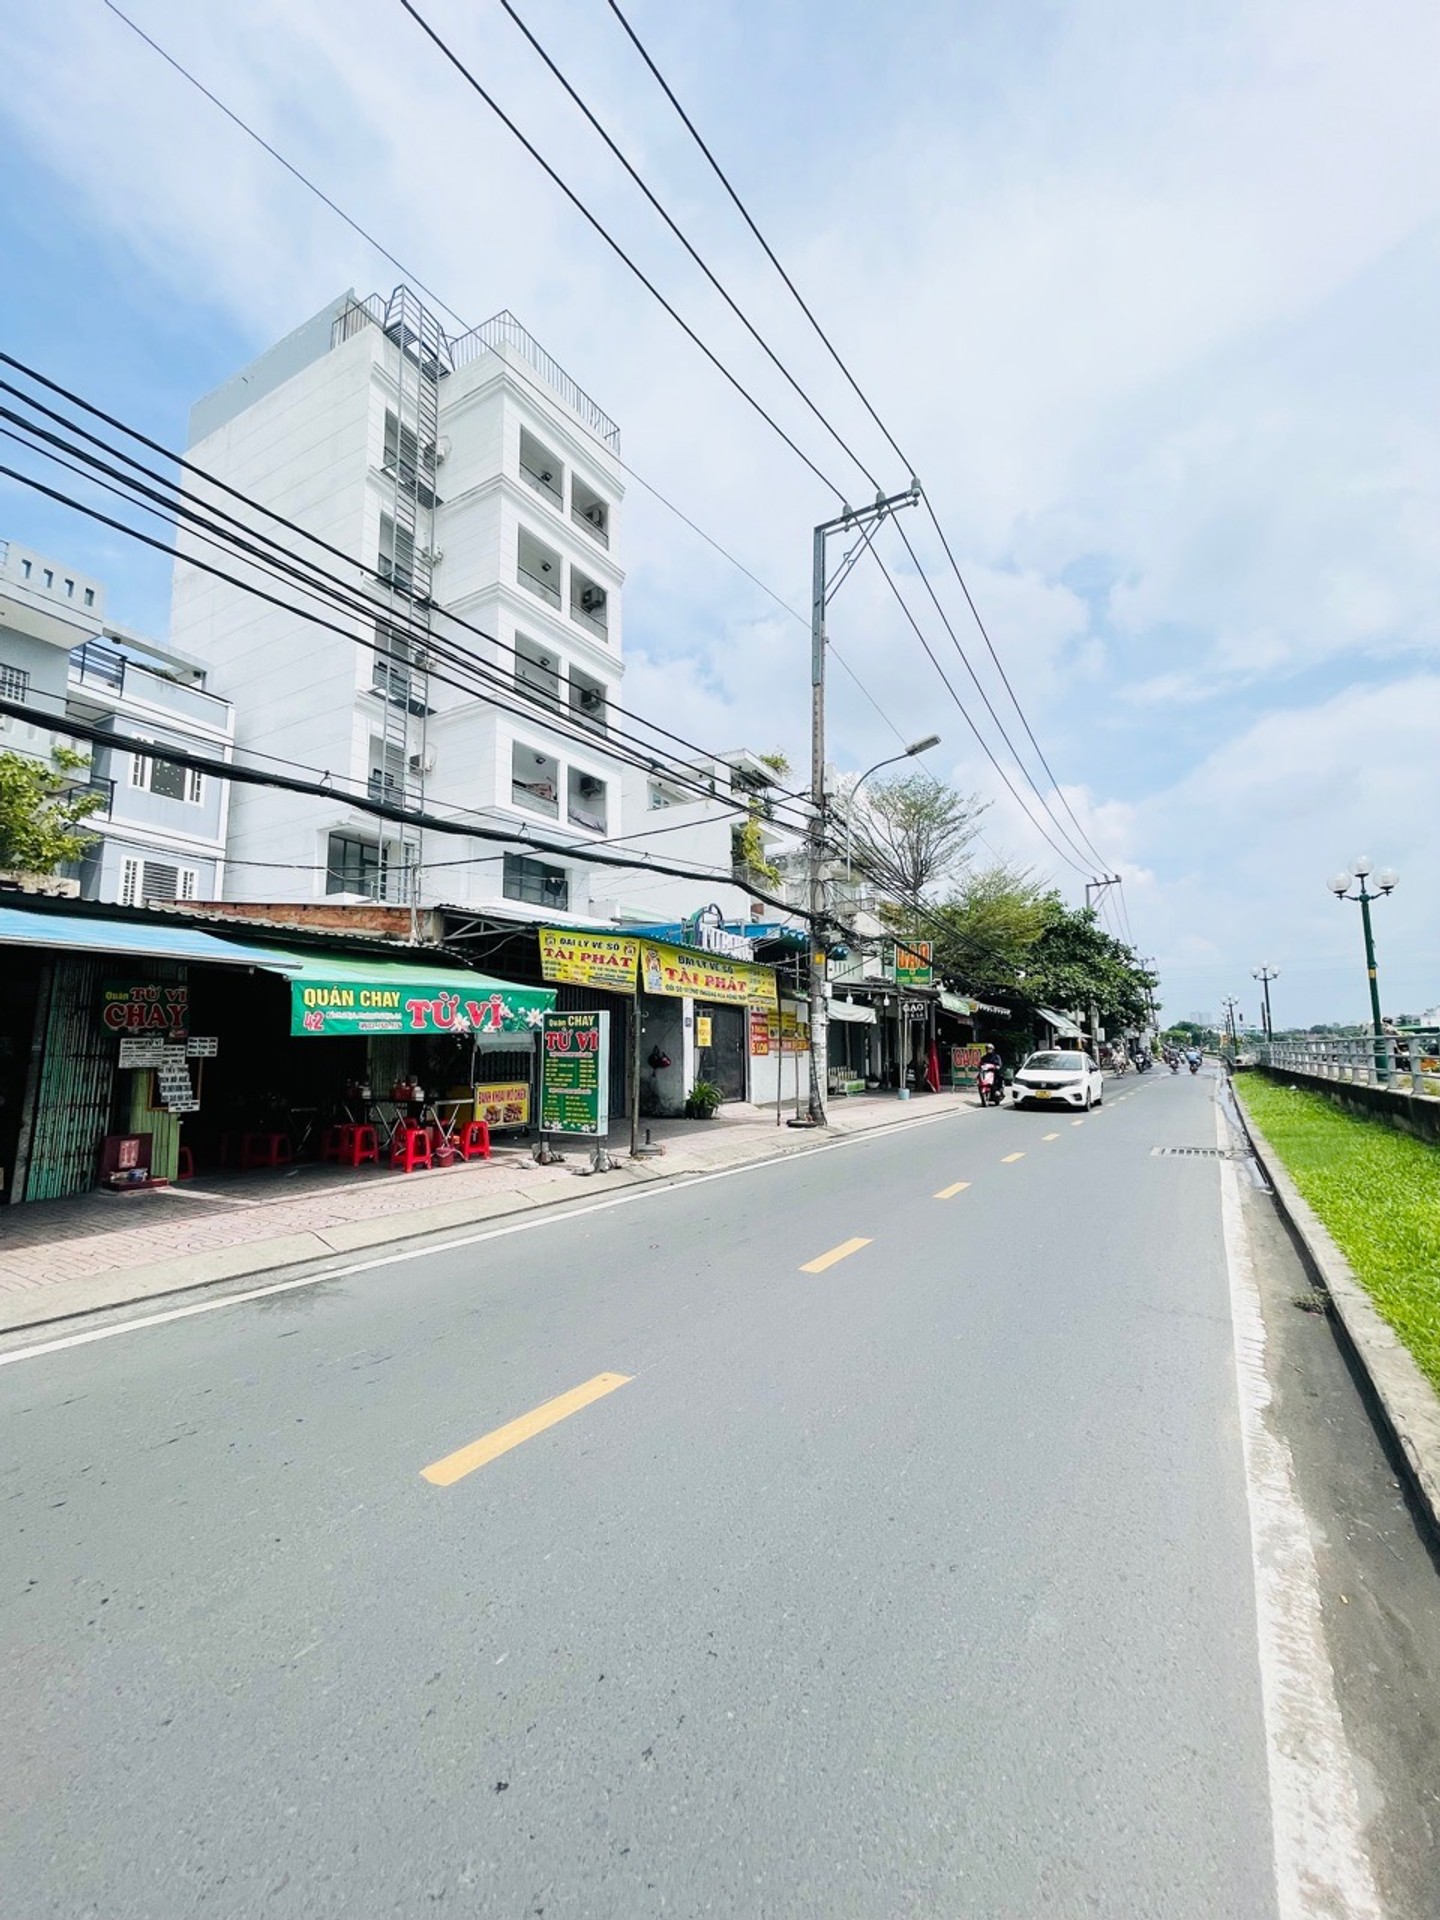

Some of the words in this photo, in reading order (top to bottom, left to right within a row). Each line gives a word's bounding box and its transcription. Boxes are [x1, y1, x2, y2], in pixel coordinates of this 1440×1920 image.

[664, 967, 699, 986] TÀI
[704, 974, 748, 992] PHÁT
[304, 986, 354, 1007] QUÁN
[360, 990, 400, 1007] CHAY
[104, 1002, 188, 1030] CHAY
[405, 992, 461, 1029] TỪ
[568, 1015, 594, 1026] CHAY
